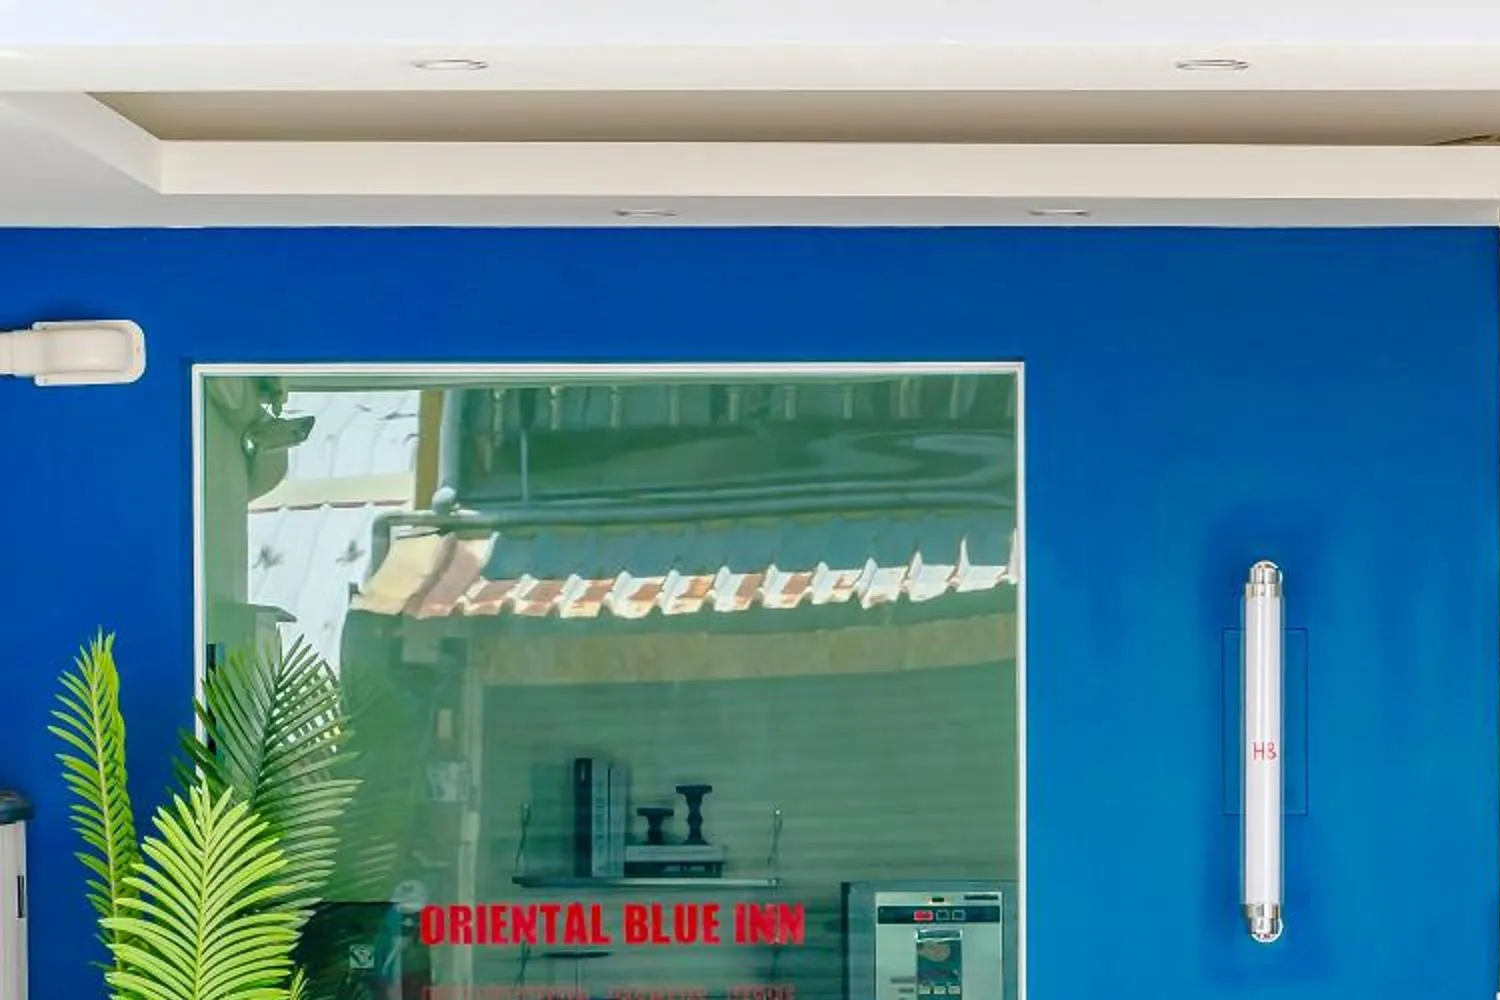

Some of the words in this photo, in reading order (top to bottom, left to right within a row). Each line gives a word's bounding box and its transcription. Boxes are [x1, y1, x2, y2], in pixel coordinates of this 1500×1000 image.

[420, 903, 613, 946] ORIENTAL
[624, 903, 721, 946] BLUE
[735, 903, 806, 946] INN
